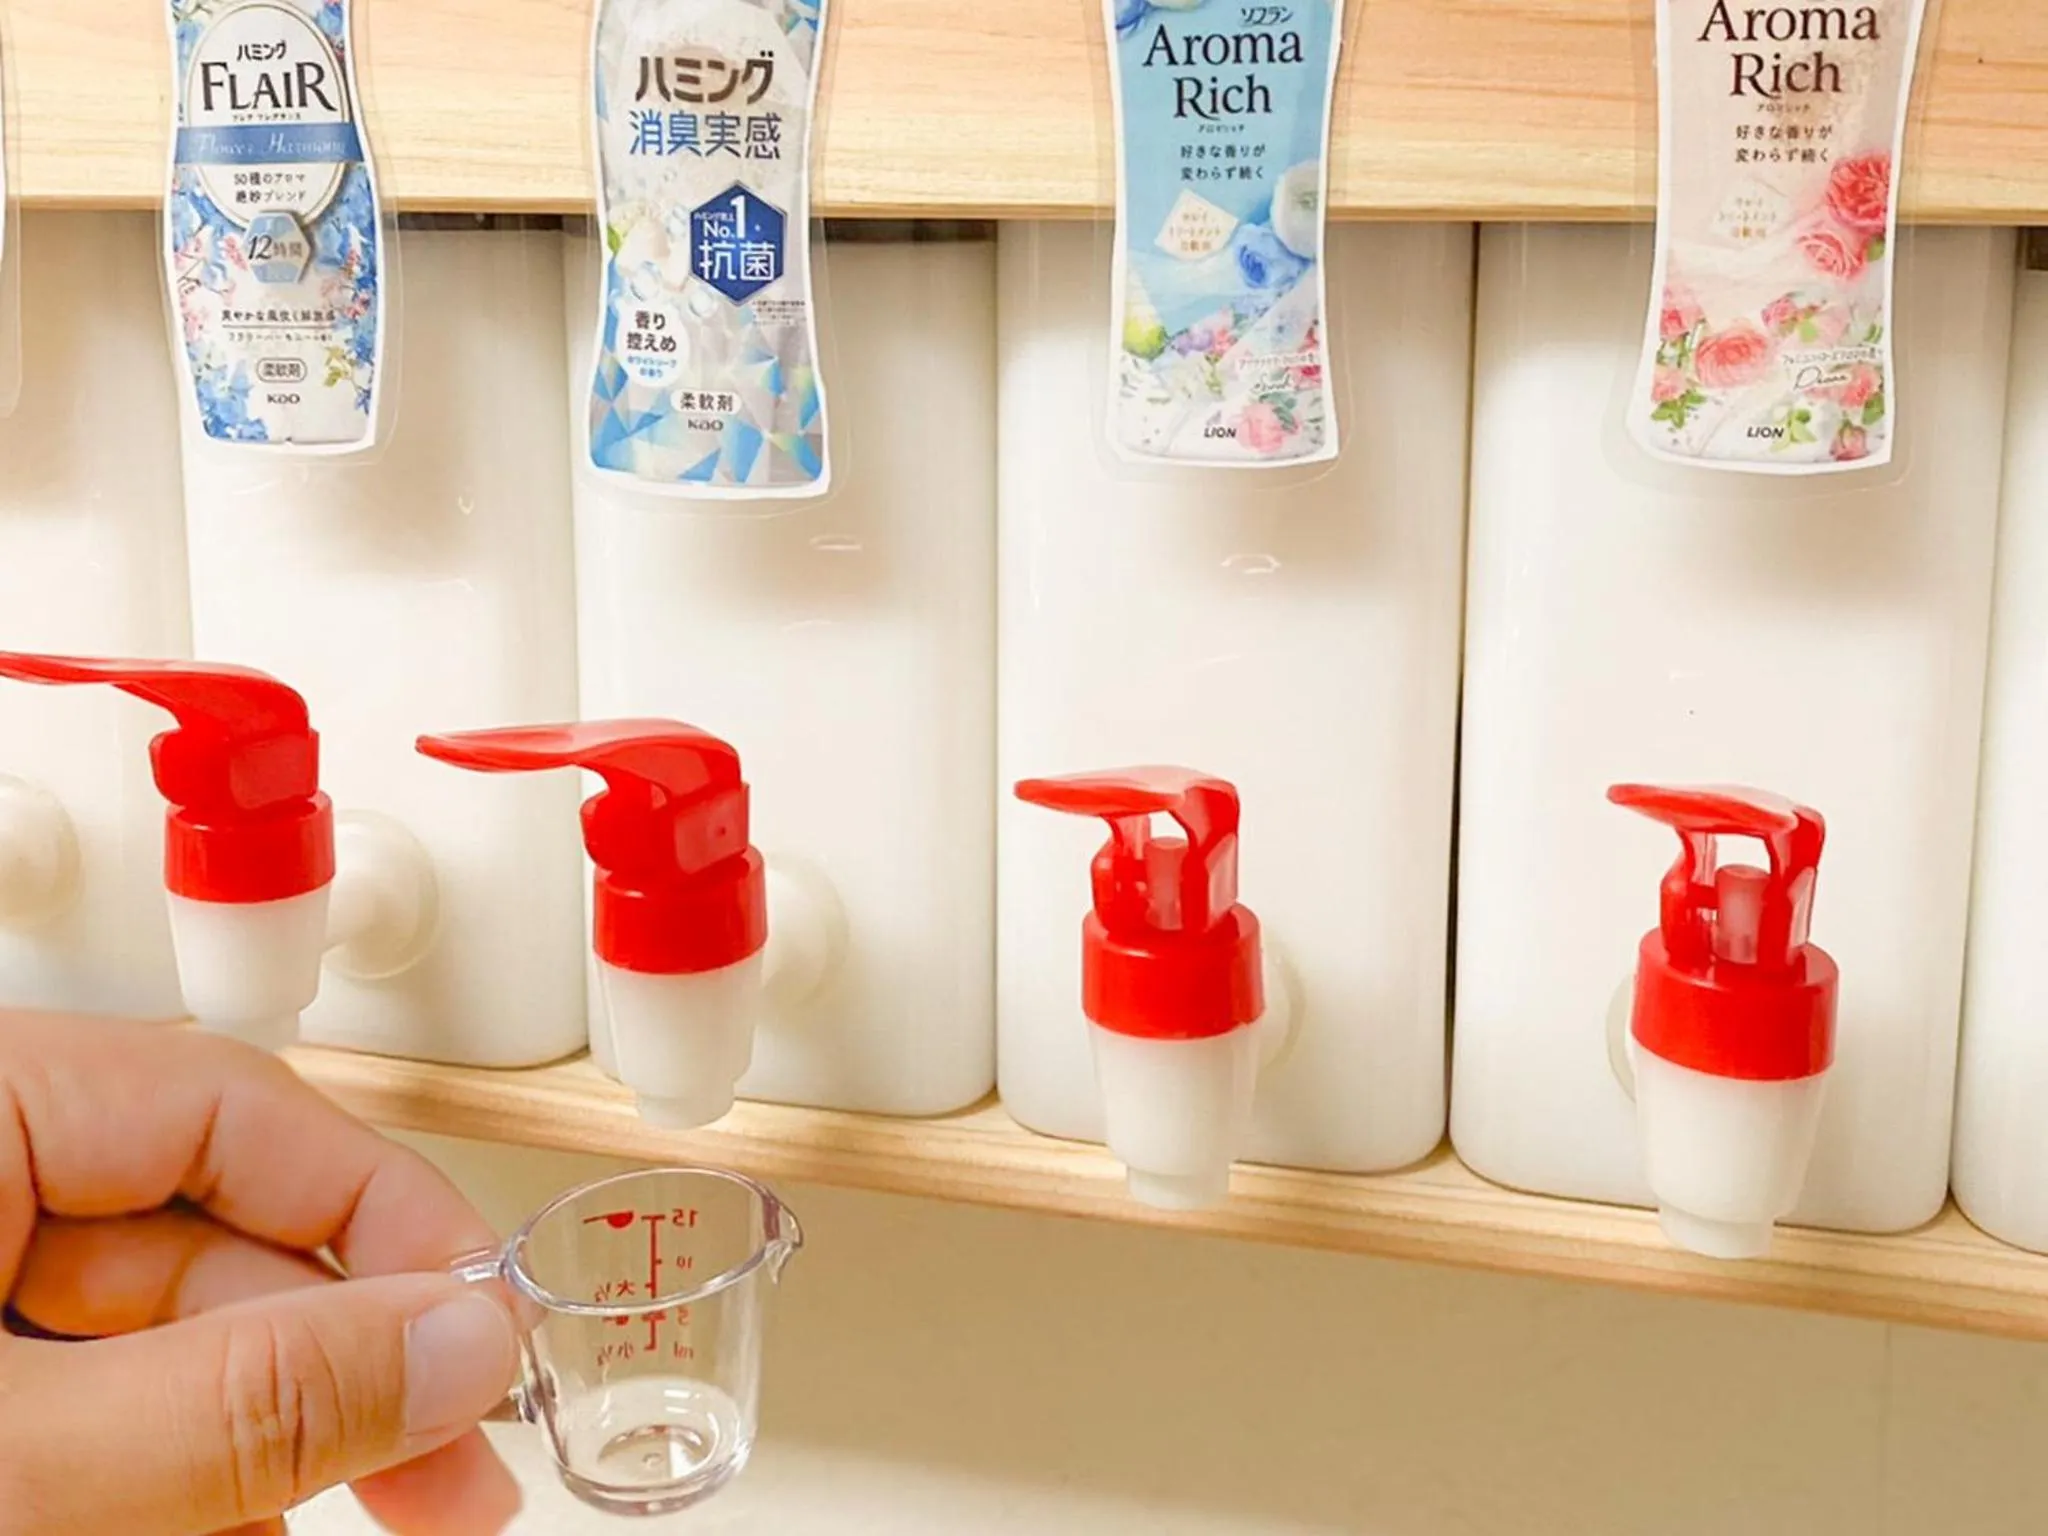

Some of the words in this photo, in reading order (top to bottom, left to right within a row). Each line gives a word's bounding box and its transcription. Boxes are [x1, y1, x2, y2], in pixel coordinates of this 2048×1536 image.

[1241, 6, 1293, 26] ソフラン
[1697, 0, 1880, 42] Aroma
[236, 40, 287, 61] ハミング
[1142, 23, 1304, 66] Aroma
[634, 50, 774, 105] ハミング
[1730, 51, 1843, 99] Rich
[200, 61, 338, 112] FLAIR
[1172, 73, 1272, 120] Rich
[628, 108, 783, 160] 消臭実感
[1735, 124, 1833, 140] 好きな香りが
[1180, 143, 1266, 159] 好きな香りが
[1735, 148, 1829, 163] 変わらず続く
[1180, 166, 1264, 181] 変わらず続く
[699, 240, 776, 281] 抗菌
[635, 310, 666, 331] 香り
[626, 332, 677, 353] 控えめ
[680, 391, 733, 412] 柔軟剤
[1204, 428, 1237, 438] LION
[1746, 427, 1784, 438] LION
